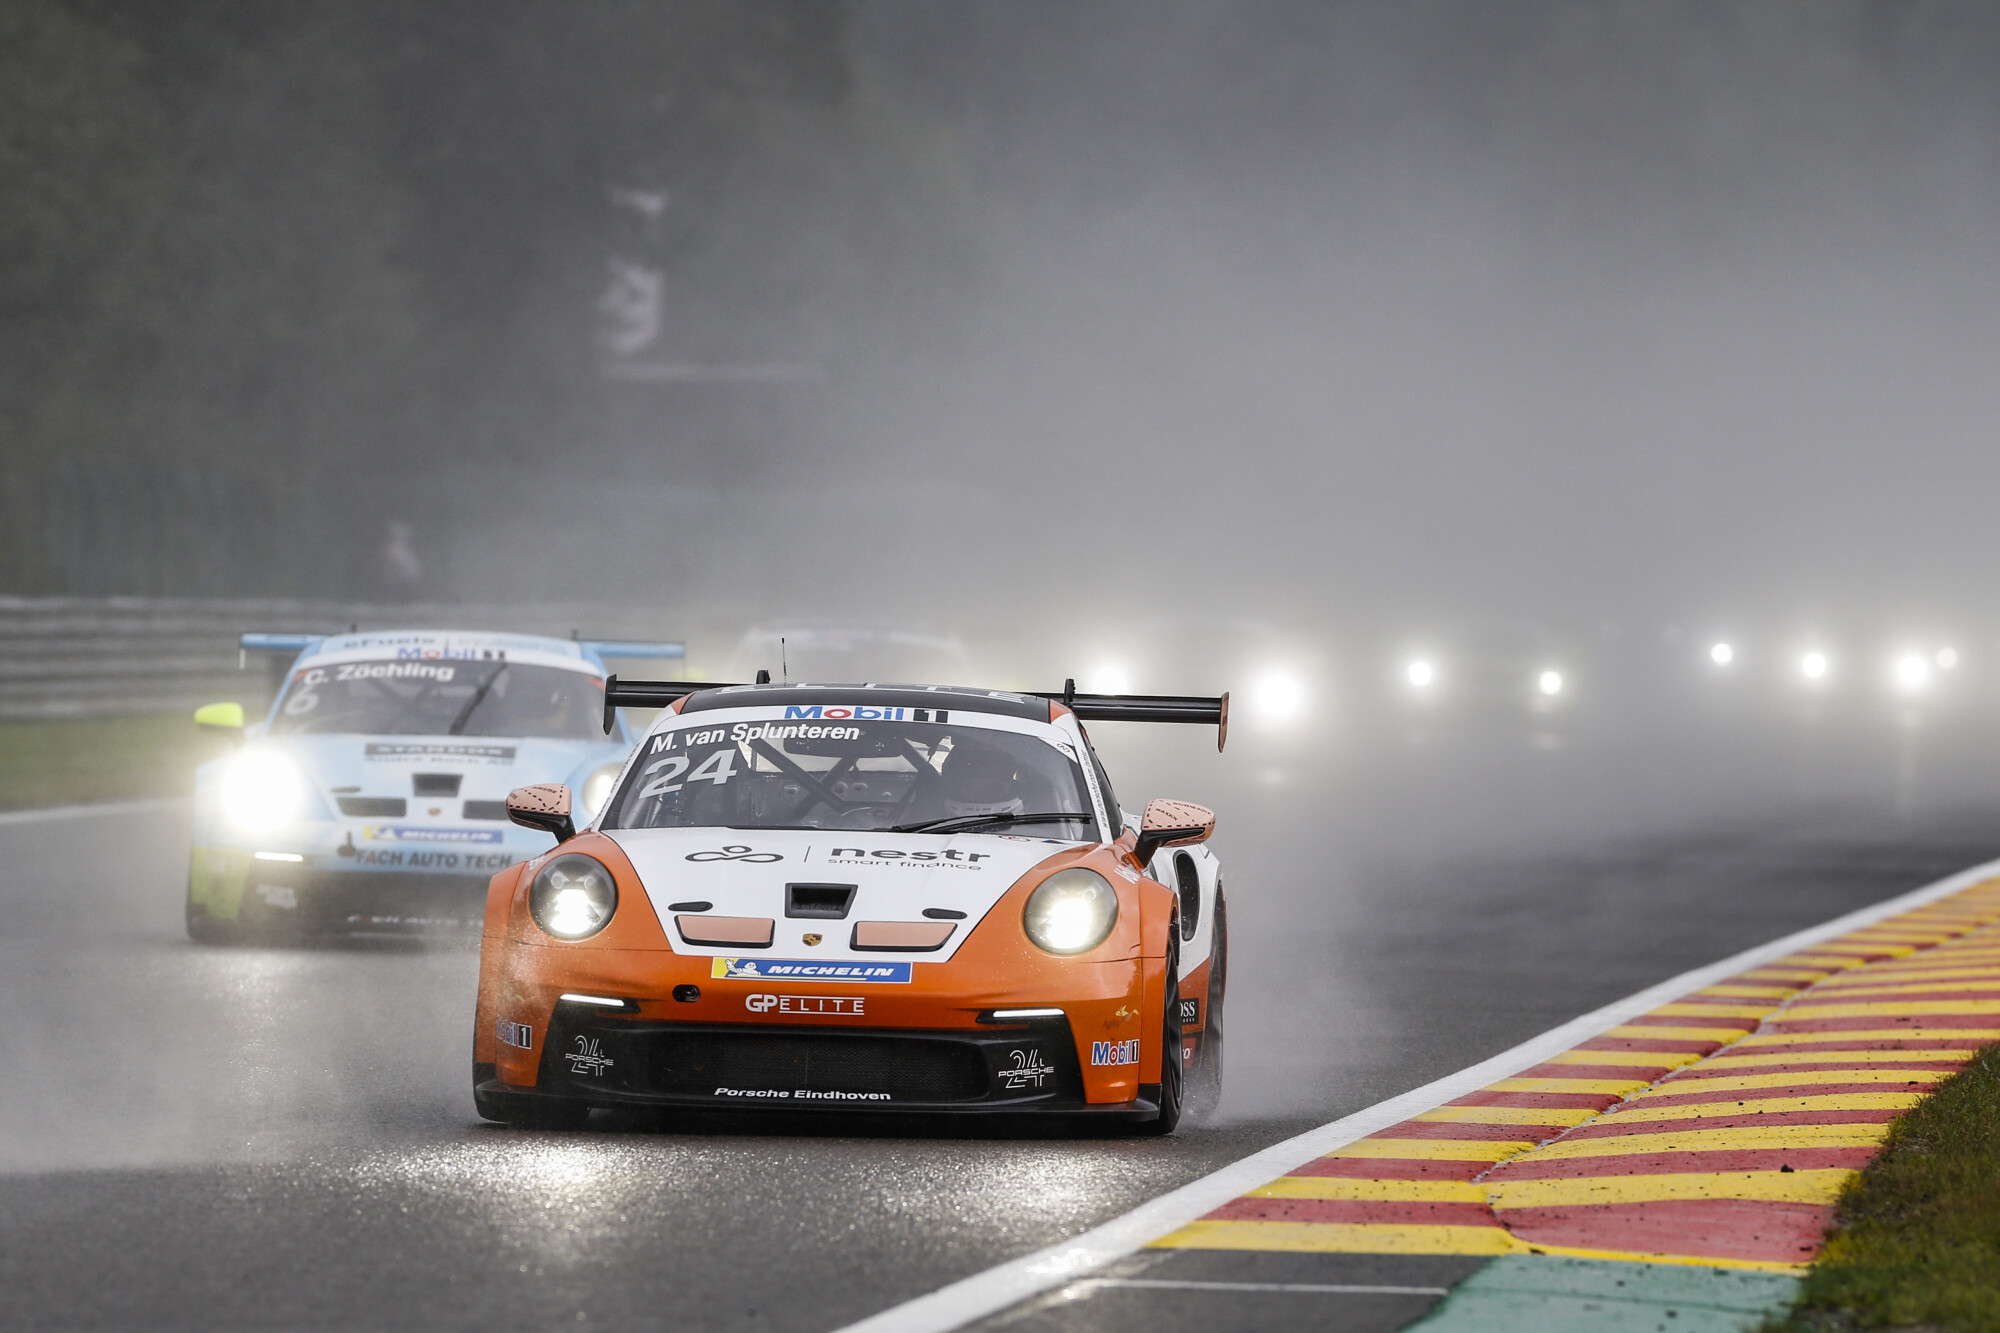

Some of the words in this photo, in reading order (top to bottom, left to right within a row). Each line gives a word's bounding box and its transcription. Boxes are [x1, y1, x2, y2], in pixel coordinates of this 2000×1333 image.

[397, 647, 475, 660] Mobil
[304, 669, 330, 685] C.
[336, 663, 455, 682] Zöchling
[784, 706, 904, 721] Mobil
[650, 732, 678, 754] M.
[685, 728, 725, 747] van
[730, 722, 860, 745] Splunteren
[638, 749, 737, 800] 24
[408, 852, 458, 868] AUTO
[464, 855, 513, 869] TECH
[831, 847, 991, 863] nestr
[827, 858, 892, 867] smart
[900, 861, 982, 871] finance
[767, 965, 895, 977] MICHELIN
[565, 1053, 614, 1066] PORSCHE
[1091, 1040, 1131, 1066] Mobil
[1131, 1039, 1140, 1063] 1
[998, 1066, 1054, 1078] PORSCHE
[714, 1087, 790, 1097] Porsche
[794, 1089, 891, 1100] Eindhoven
